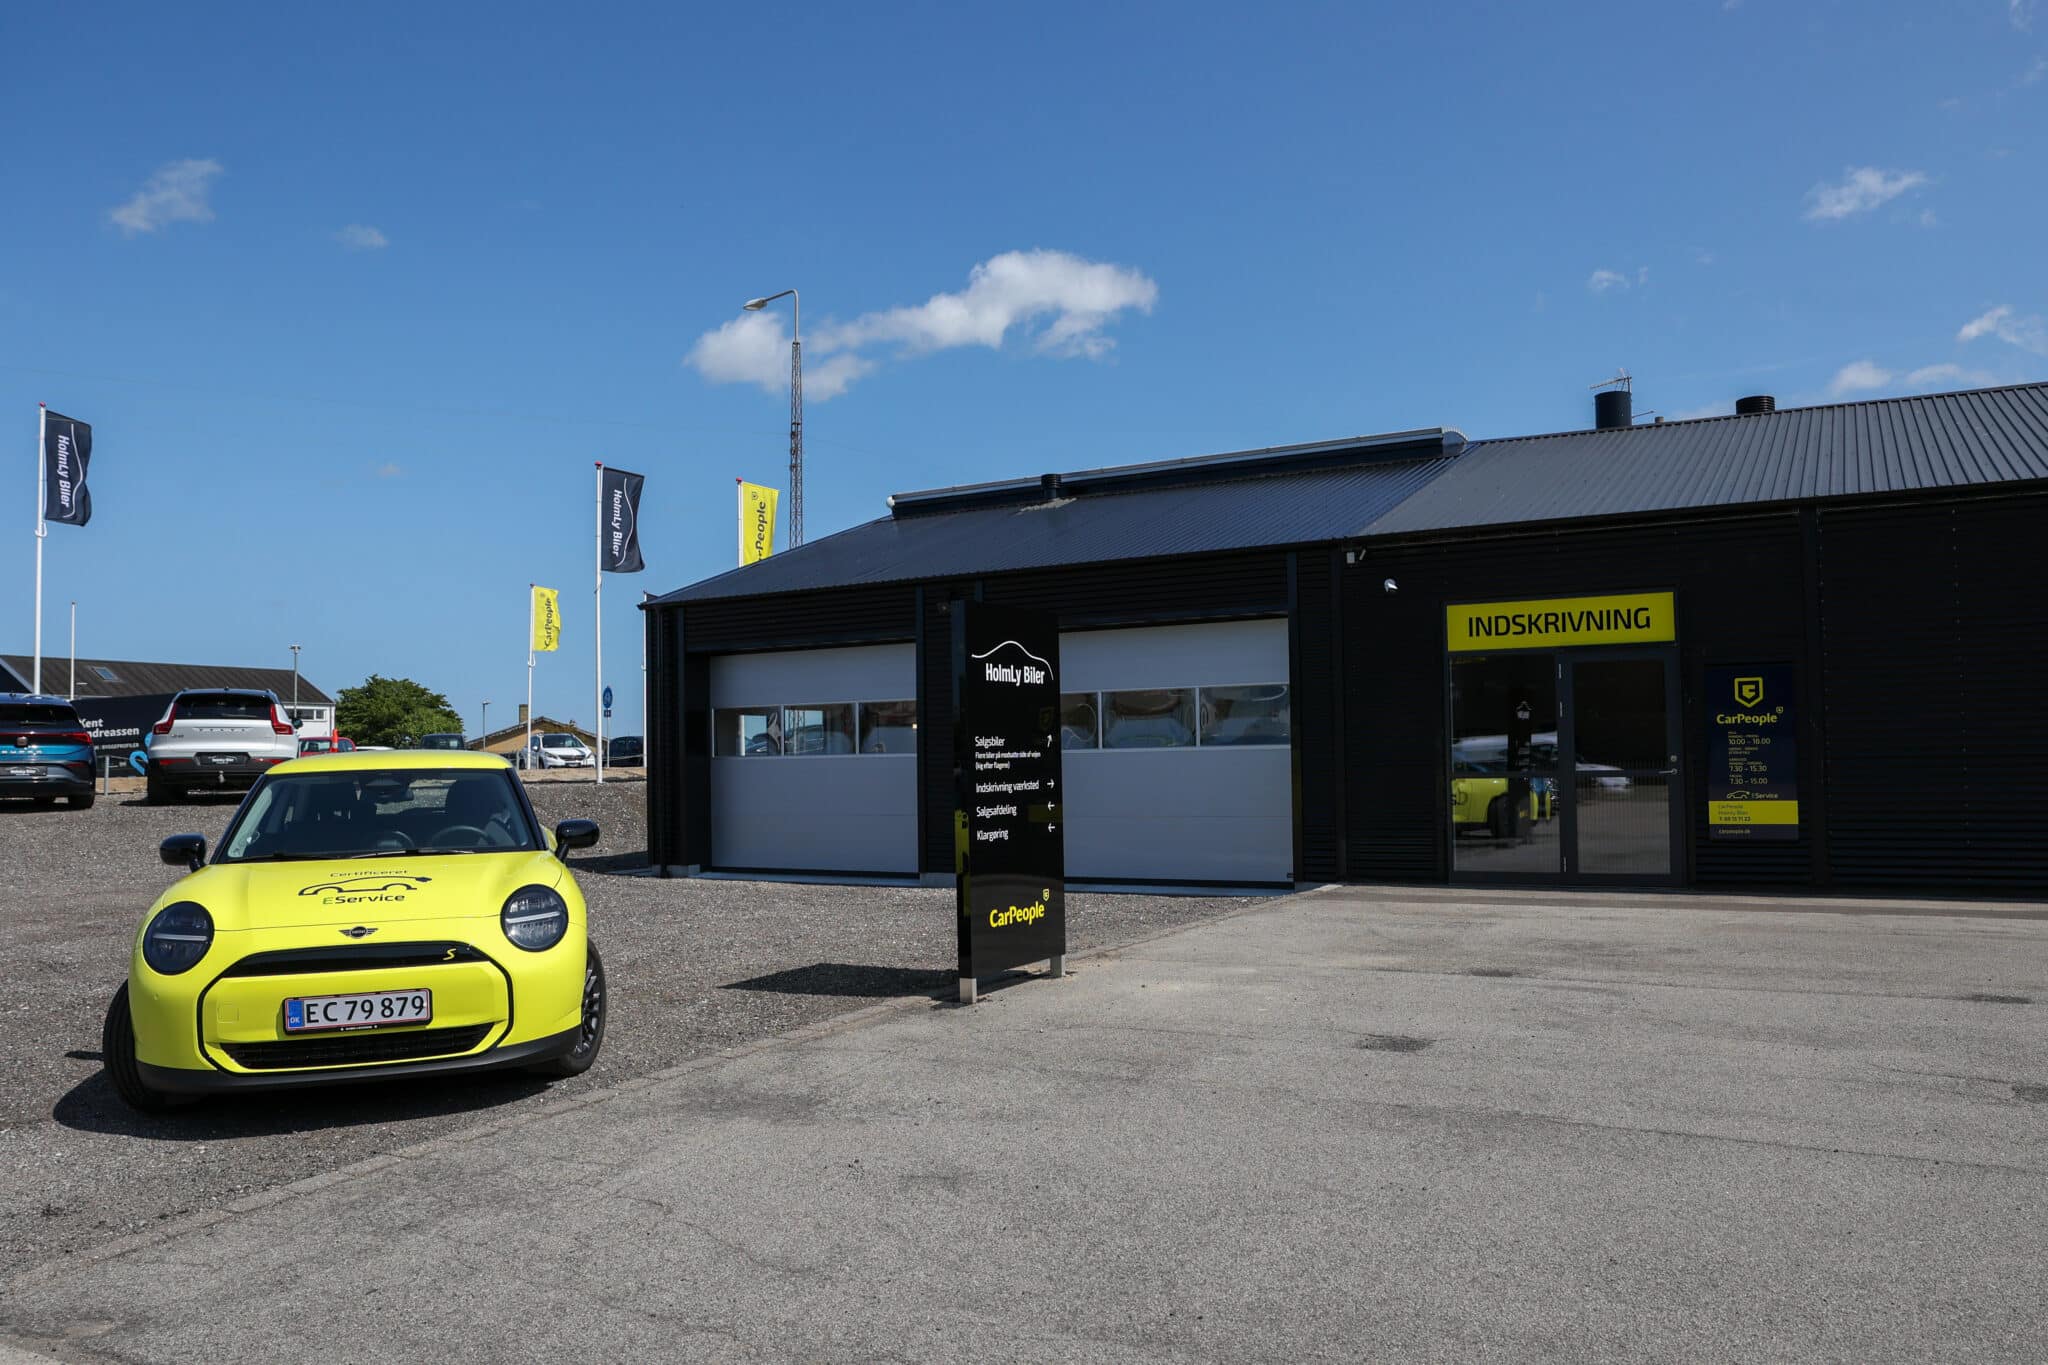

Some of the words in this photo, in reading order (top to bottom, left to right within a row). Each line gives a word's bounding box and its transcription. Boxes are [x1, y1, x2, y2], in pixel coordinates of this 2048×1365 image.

[59, 480, 71, 508] Biler
[755, 501, 768, 560] rPeople
[1468, 607, 1651, 637] INDSKRIVNING
[985, 662, 1022, 687] HolmLy
[1023, 665, 1045, 685] Biler
[1716, 712, 1778, 726] CarPeople
[86, 727, 140, 738] ndreassen
[974, 735, 1005, 749] Salgsbiler
[975, 781, 1013, 794] Indskrivning
[976, 804, 1017, 819] Salgsafdeling
[976, 828, 1009, 842] Klargøring
[989, 900, 1045, 928] CarPeople
[290, 1016, 300, 1024] DK
[305, 1001, 338, 1024] EC
